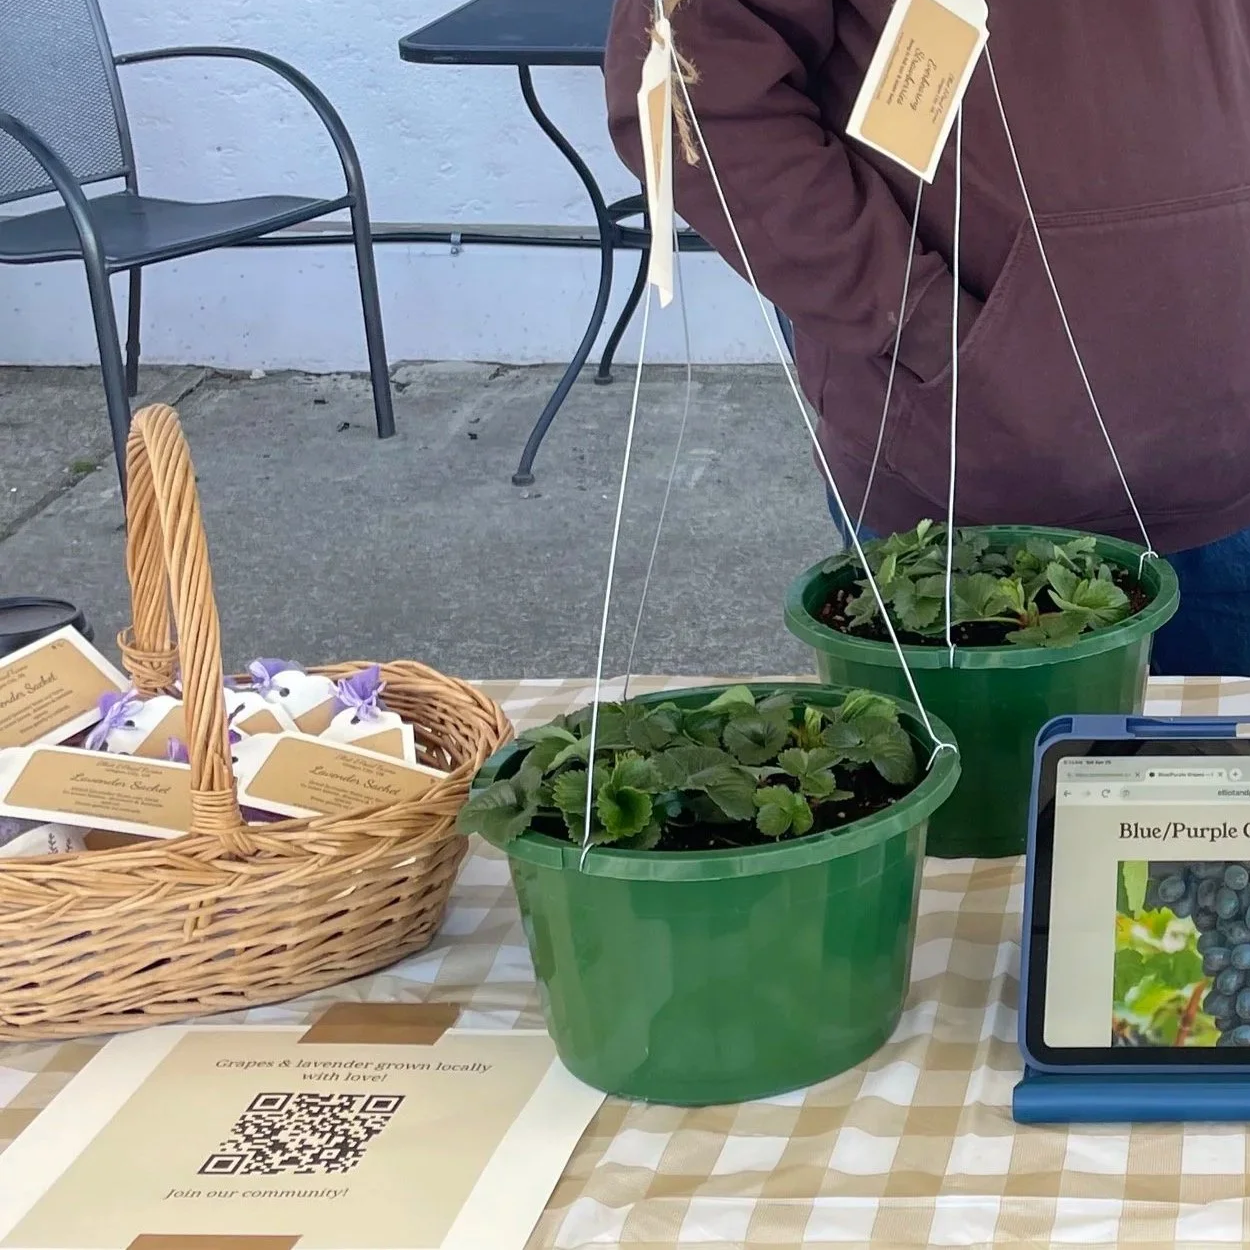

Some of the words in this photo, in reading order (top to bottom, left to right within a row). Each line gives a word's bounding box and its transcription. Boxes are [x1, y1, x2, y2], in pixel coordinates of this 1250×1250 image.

[70, 772, 126, 788] Lavender
[130, 780, 172, 795] Sachet
[309, 765, 360, 786] Lavender
[363, 778, 400, 796] Sachet
[1118, 821, 1239, 842] Blue/Purple
[215, 1058, 274, 1069] Grapes
[278, 1058, 292, 1068] &
[296, 1058, 375, 1070] lavender
[374, 1062, 431, 1072] grown
[435, 1061, 495, 1074] locally
[302, 1071, 340, 1082] with
[344, 1071, 389, 1083] love!
[164, 1187, 202, 1200] Join
[206, 1190, 239, 1198] our
[242, 1187, 350, 1200] community!
